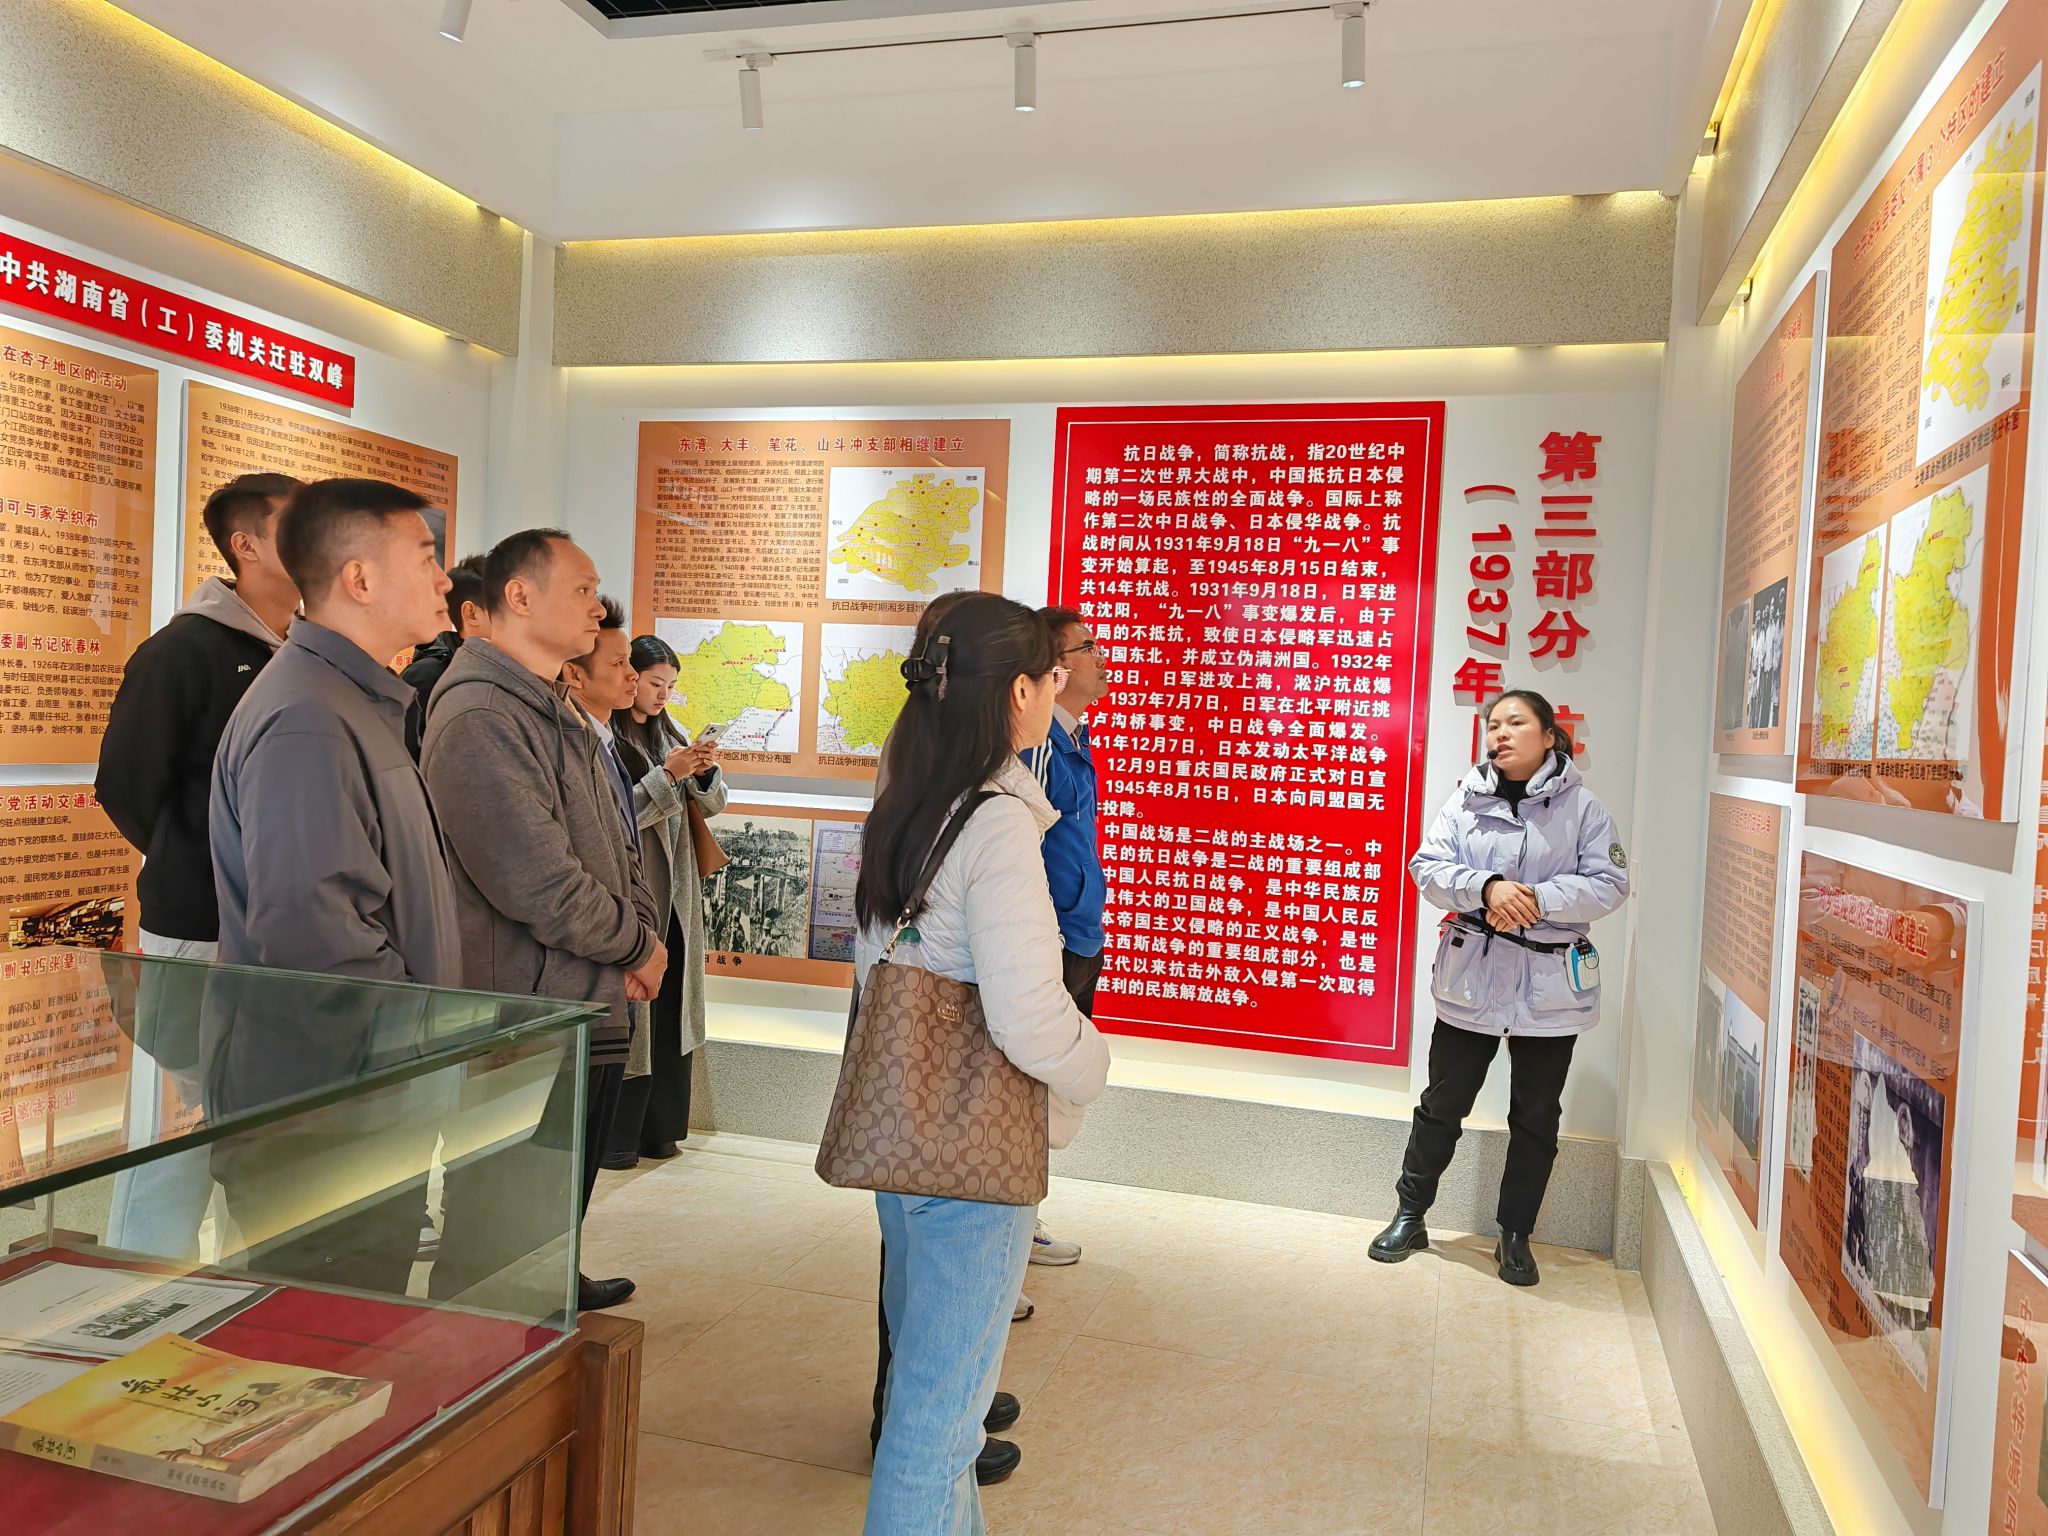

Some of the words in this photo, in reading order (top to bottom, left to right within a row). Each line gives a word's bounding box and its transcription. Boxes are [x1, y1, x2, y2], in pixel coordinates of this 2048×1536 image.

[0, 251, 343, 389] 中共湖南省（工）委机关迁驻双峰
[3, 345, 127, 391] 在杏子地区的活动
[679, 437, 966, 453] 东湾、大丰、笔花、山斗冲支部相继建立
[1124, 443, 1405, 462] 抗日战争，简称抗战，指20世纪中
[1085, 466, 1404, 485] 期第二次世界大战中，中国抵抗日本侵
[1085, 489, 1403, 508] 略的一场民族性的全面战争。国际上称
[0, 498, 98, 528] 可与家学织布
[1084, 513, 1401, 531] 作第二次中日战争、日本侵华战争。抗
[1082, 535, 1400, 554] 战时间从1931年9月18日“九一八”事
[1528, 431, 1601, 659] 第三部分
[1081, 557, 1388, 579] 变开始算起，至1945年8月15日结束，
[1080, 579, 1397, 602] 共14年抗战。1931年9月18日，日军进
[832, 602, 929, 612] 抗日战争时期湘乡县地
[1079, 601, 1396, 625] 攻沈阳，“九一八”事变爆发后，由于
[1, 633, 101, 655] 委副书记张春林
[1453, 484, 1516, 788] （1937年—
[1090, 736, 1387, 764] 41年12月7日，日本发动太平洋战争
[1108, 757, 1386, 787] 12月9日重庆国民政府正式对日宣
[0, 793, 101, 811] 党活动交通站
[1097, 799, 1144, 818] 投降。
[1106, 779, 1384, 810] 1945年8月15日，日本向同盟国无
[1105, 822, 1382, 857] 中国战场是二战的主战场之一。中
[1102, 844, 1381, 880] 民的抗日战争是二战的重要组成部
[1103, 866, 1380, 903] 中国人民抗日战争，是中华民族历
[1105, 888, 1378, 927] 最伟大的卫国战争，是中国人民反
[1102, 909, 1377, 950] 本帝国主义侵略的正义战争，是世
[1096, 976, 1258, 1009] 胜利的民族解放战争。
